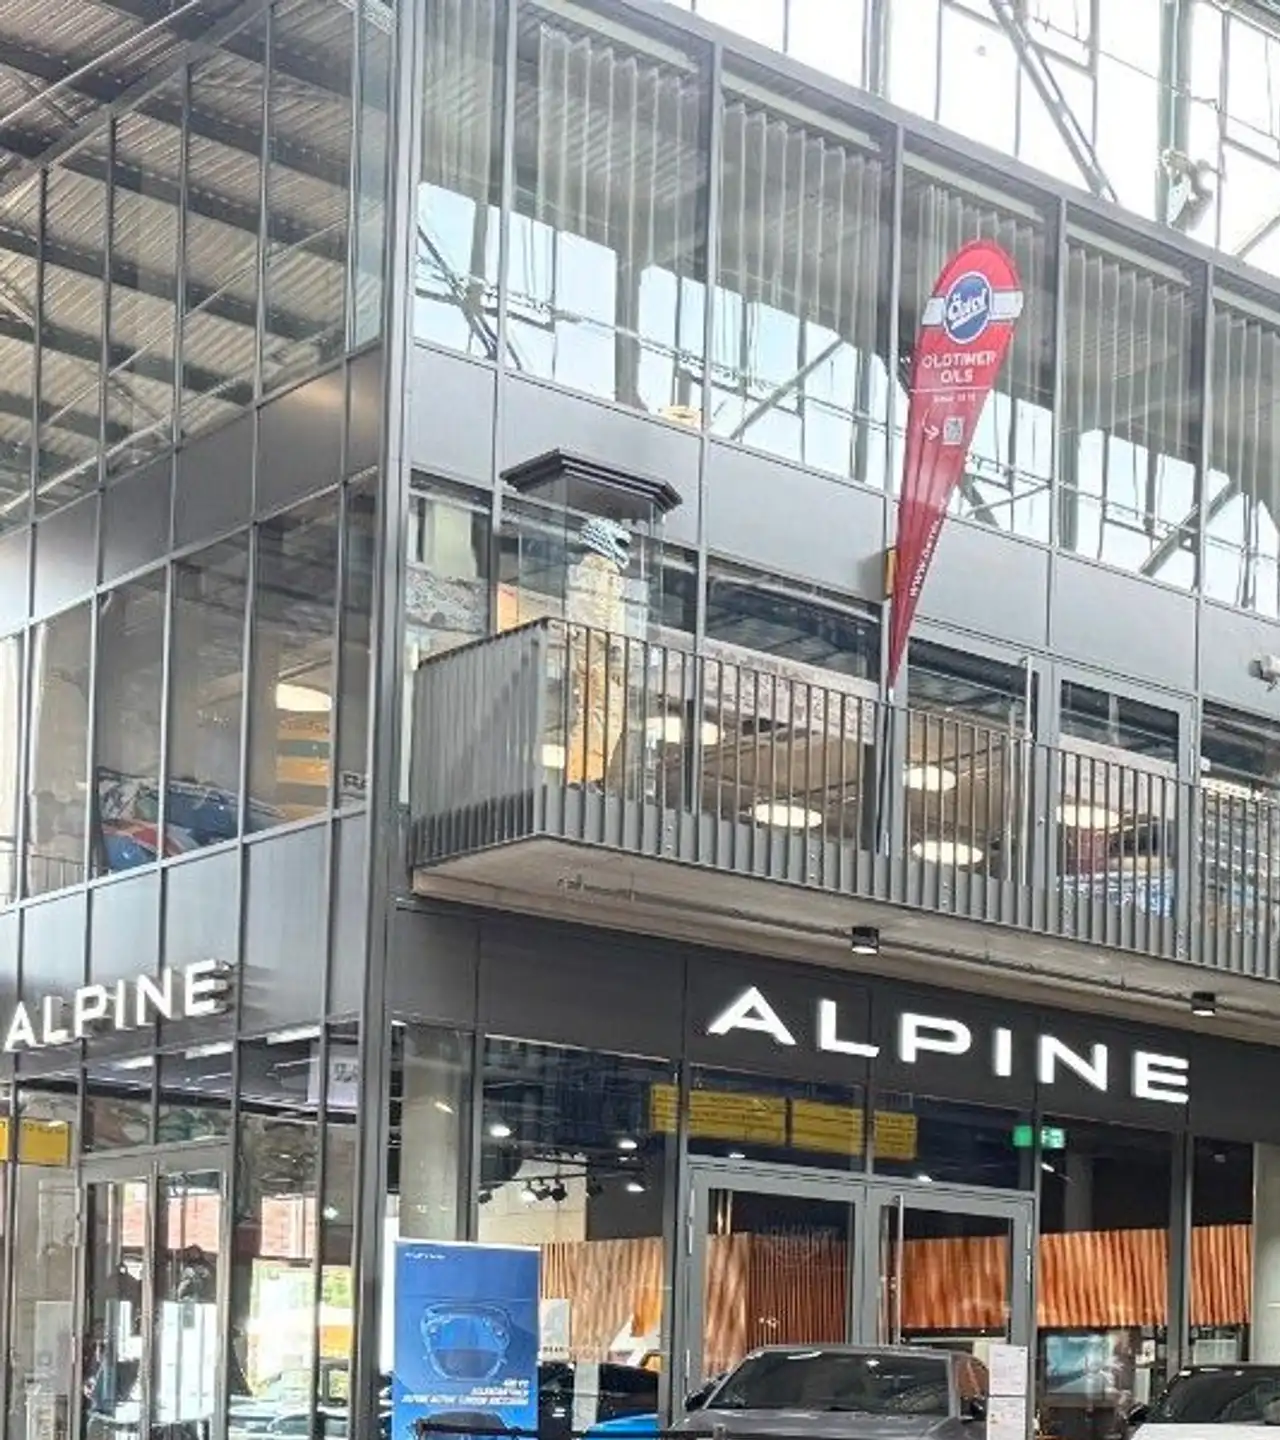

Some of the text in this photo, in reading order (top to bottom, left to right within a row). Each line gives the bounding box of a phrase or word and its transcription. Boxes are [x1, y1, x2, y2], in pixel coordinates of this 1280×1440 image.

[921, 350, 997, 368] OLDTIMER
[4, 958, 222, 1053] ALPINE
[706, 985, 1190, 1103] ALPINE
